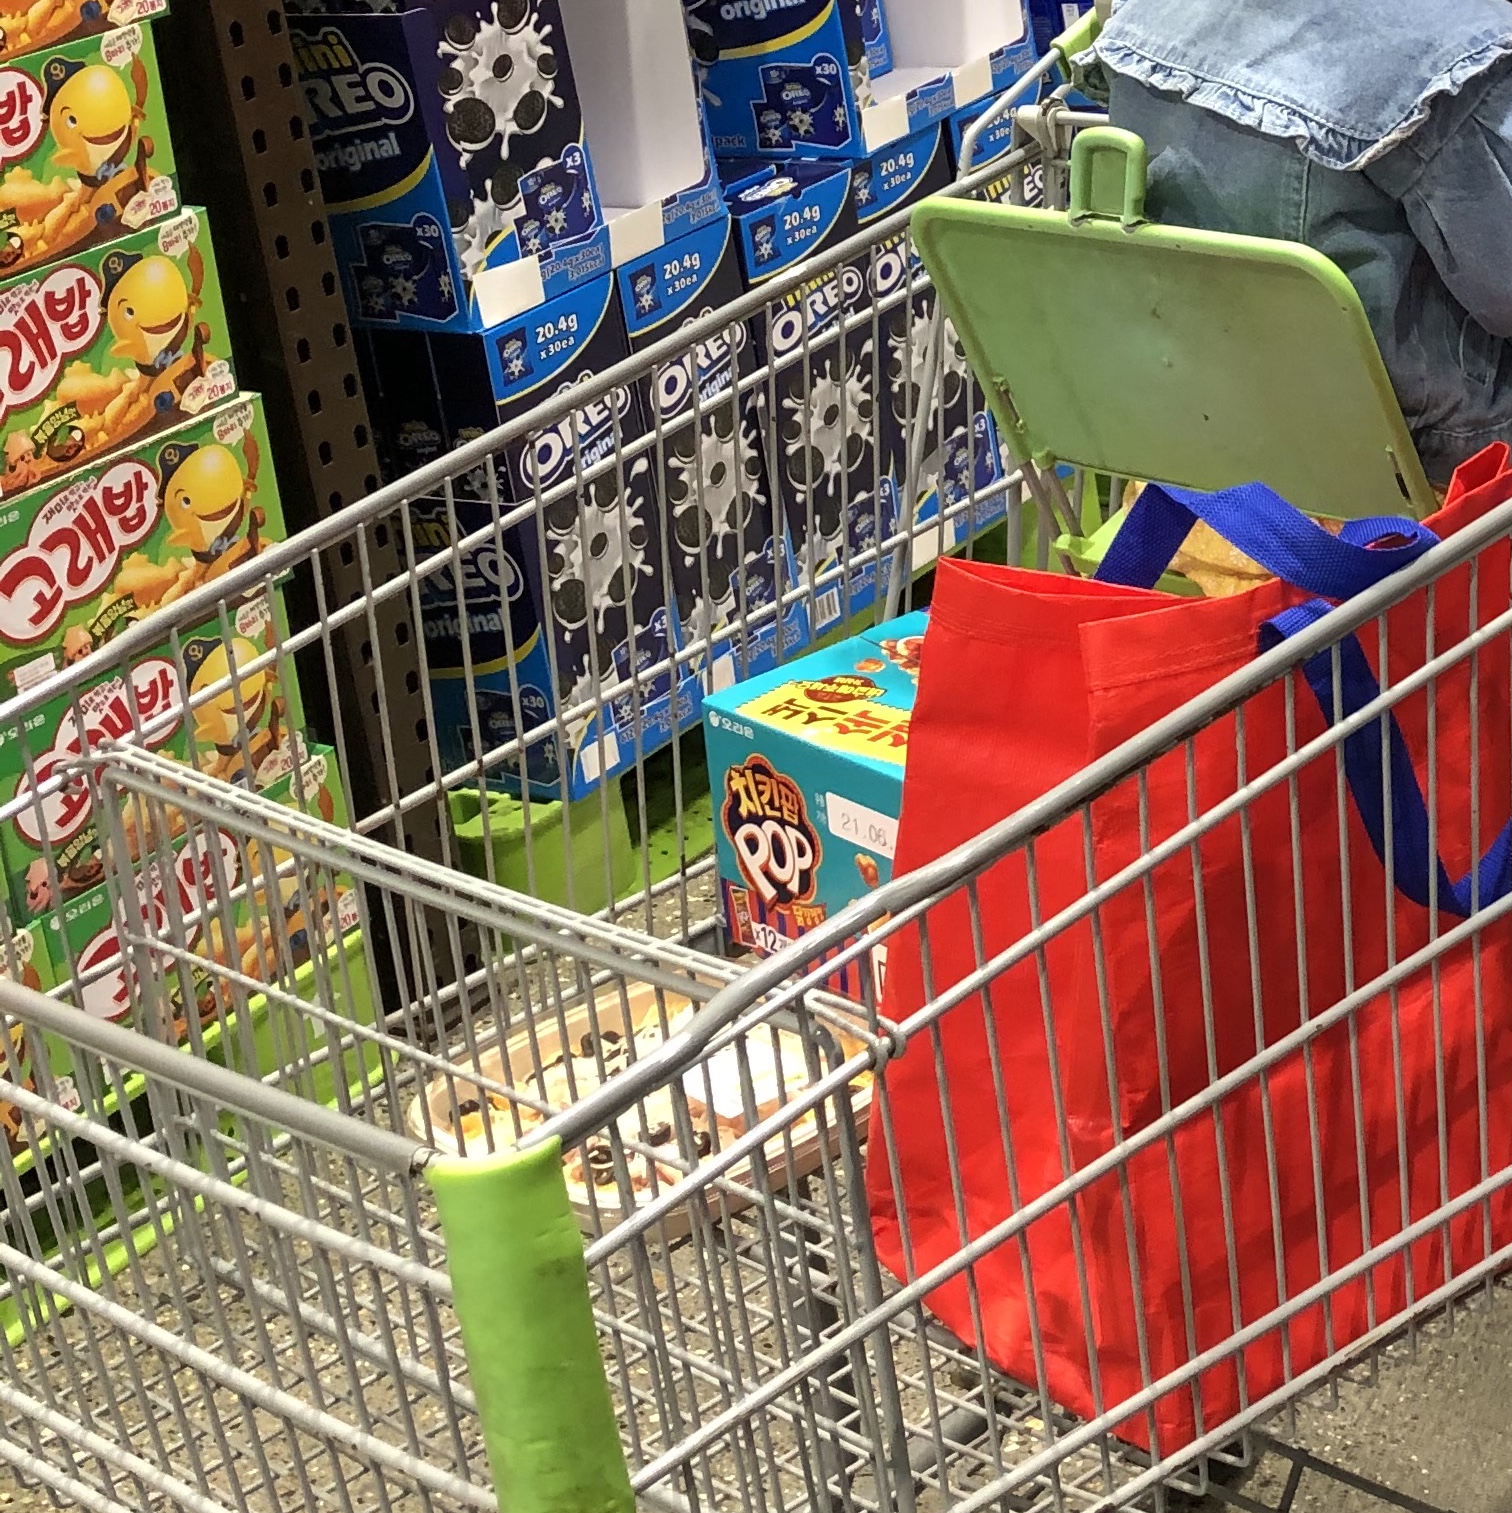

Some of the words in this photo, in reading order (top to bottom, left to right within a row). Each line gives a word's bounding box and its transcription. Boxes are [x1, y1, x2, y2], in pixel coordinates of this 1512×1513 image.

[815, 62, 838, 76] x30
[565, 152, 582, 168] x3
[879, 152, 916, 177] 20.4g
[782, 204, 821, 230] 20.4g
[415, 224, 439, 238] x30
[662, 251, 701, 280] 20.4g
[0, 276, 92, 393] 래밥
[534, 312, 579, 344] 20.4g
[0, 469, 149, 628] 고래밥
[720, 717, 755, 740] 오리온
[730, 767, 801, 826] 치킨팝
[735, 820, 813, 906] POP
